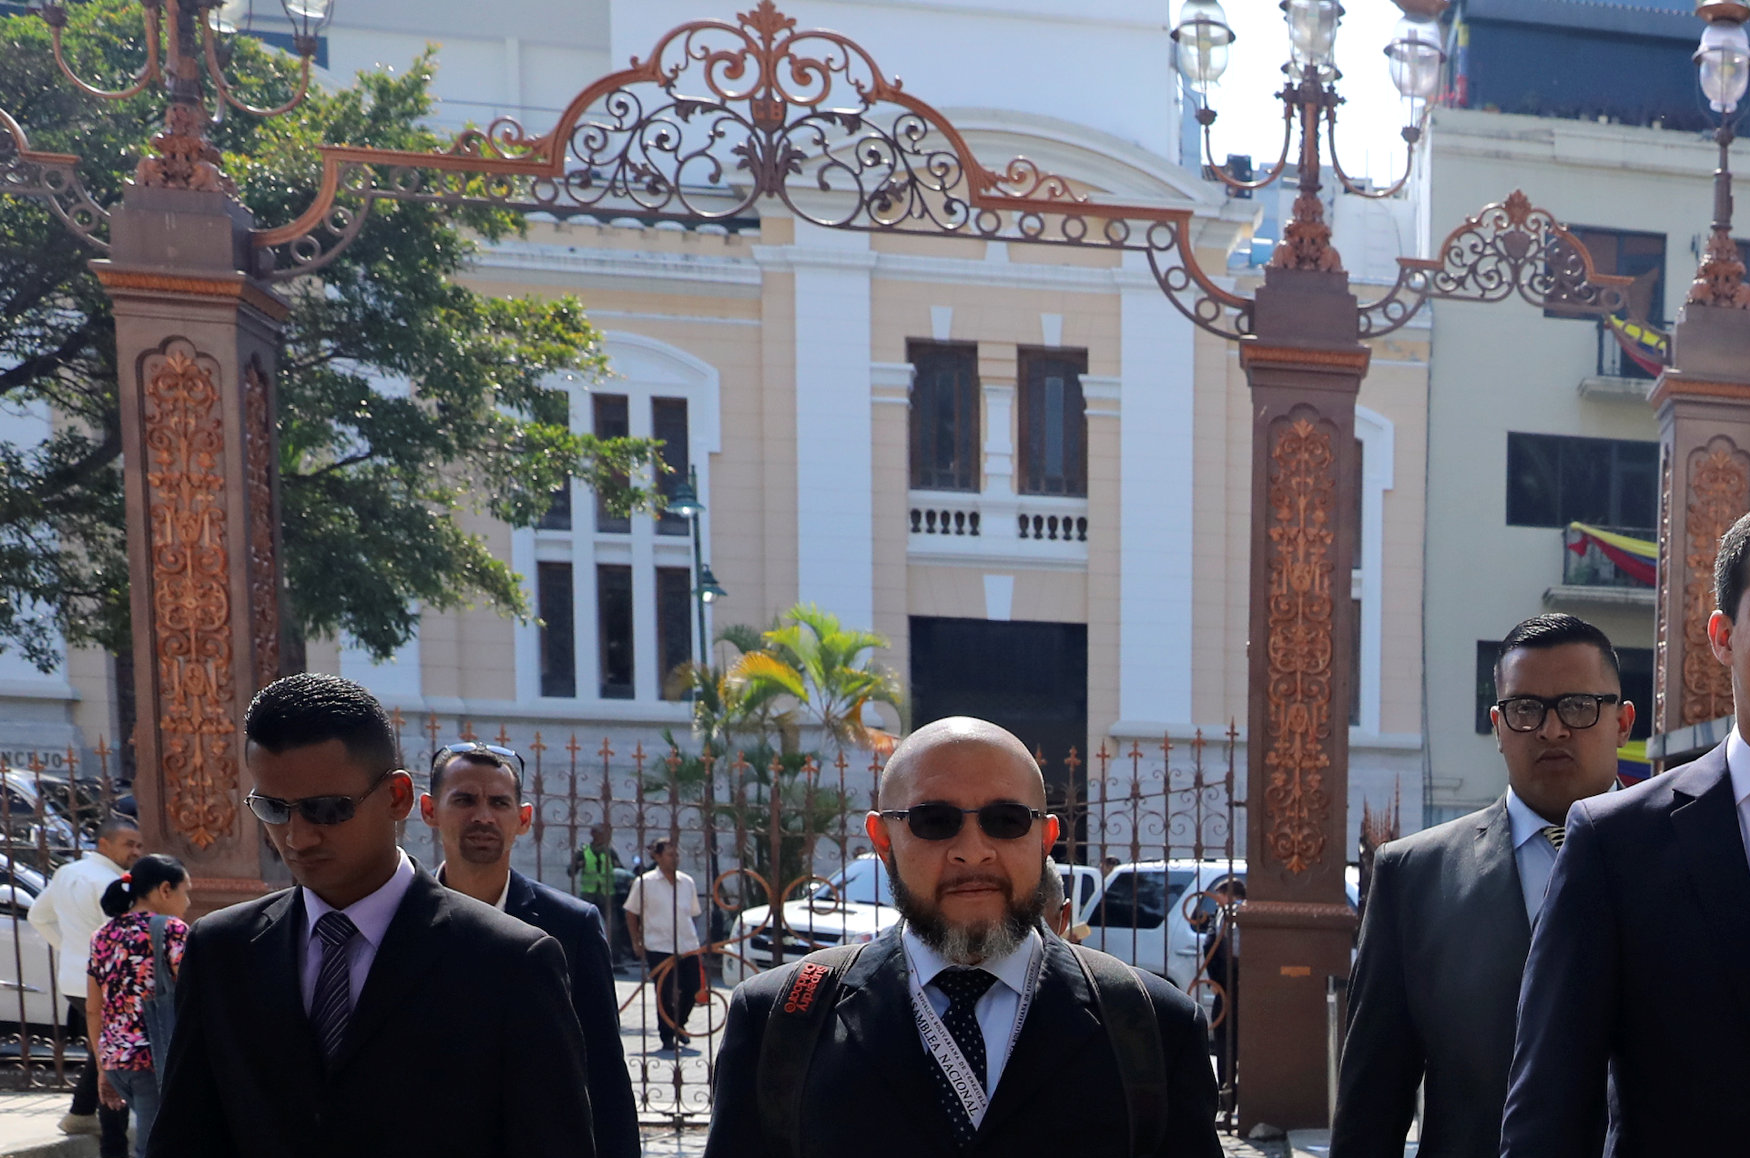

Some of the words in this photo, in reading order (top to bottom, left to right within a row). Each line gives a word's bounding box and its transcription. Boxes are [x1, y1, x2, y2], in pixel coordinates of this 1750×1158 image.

[795, 965, 828, 1012] Superdry
[933, 1020, 960, 1060] BOLIVARIANA
[965, 1071, 987, 1108] VENEZUELA
[938, 1053, 979, 1117] NACIONAL
